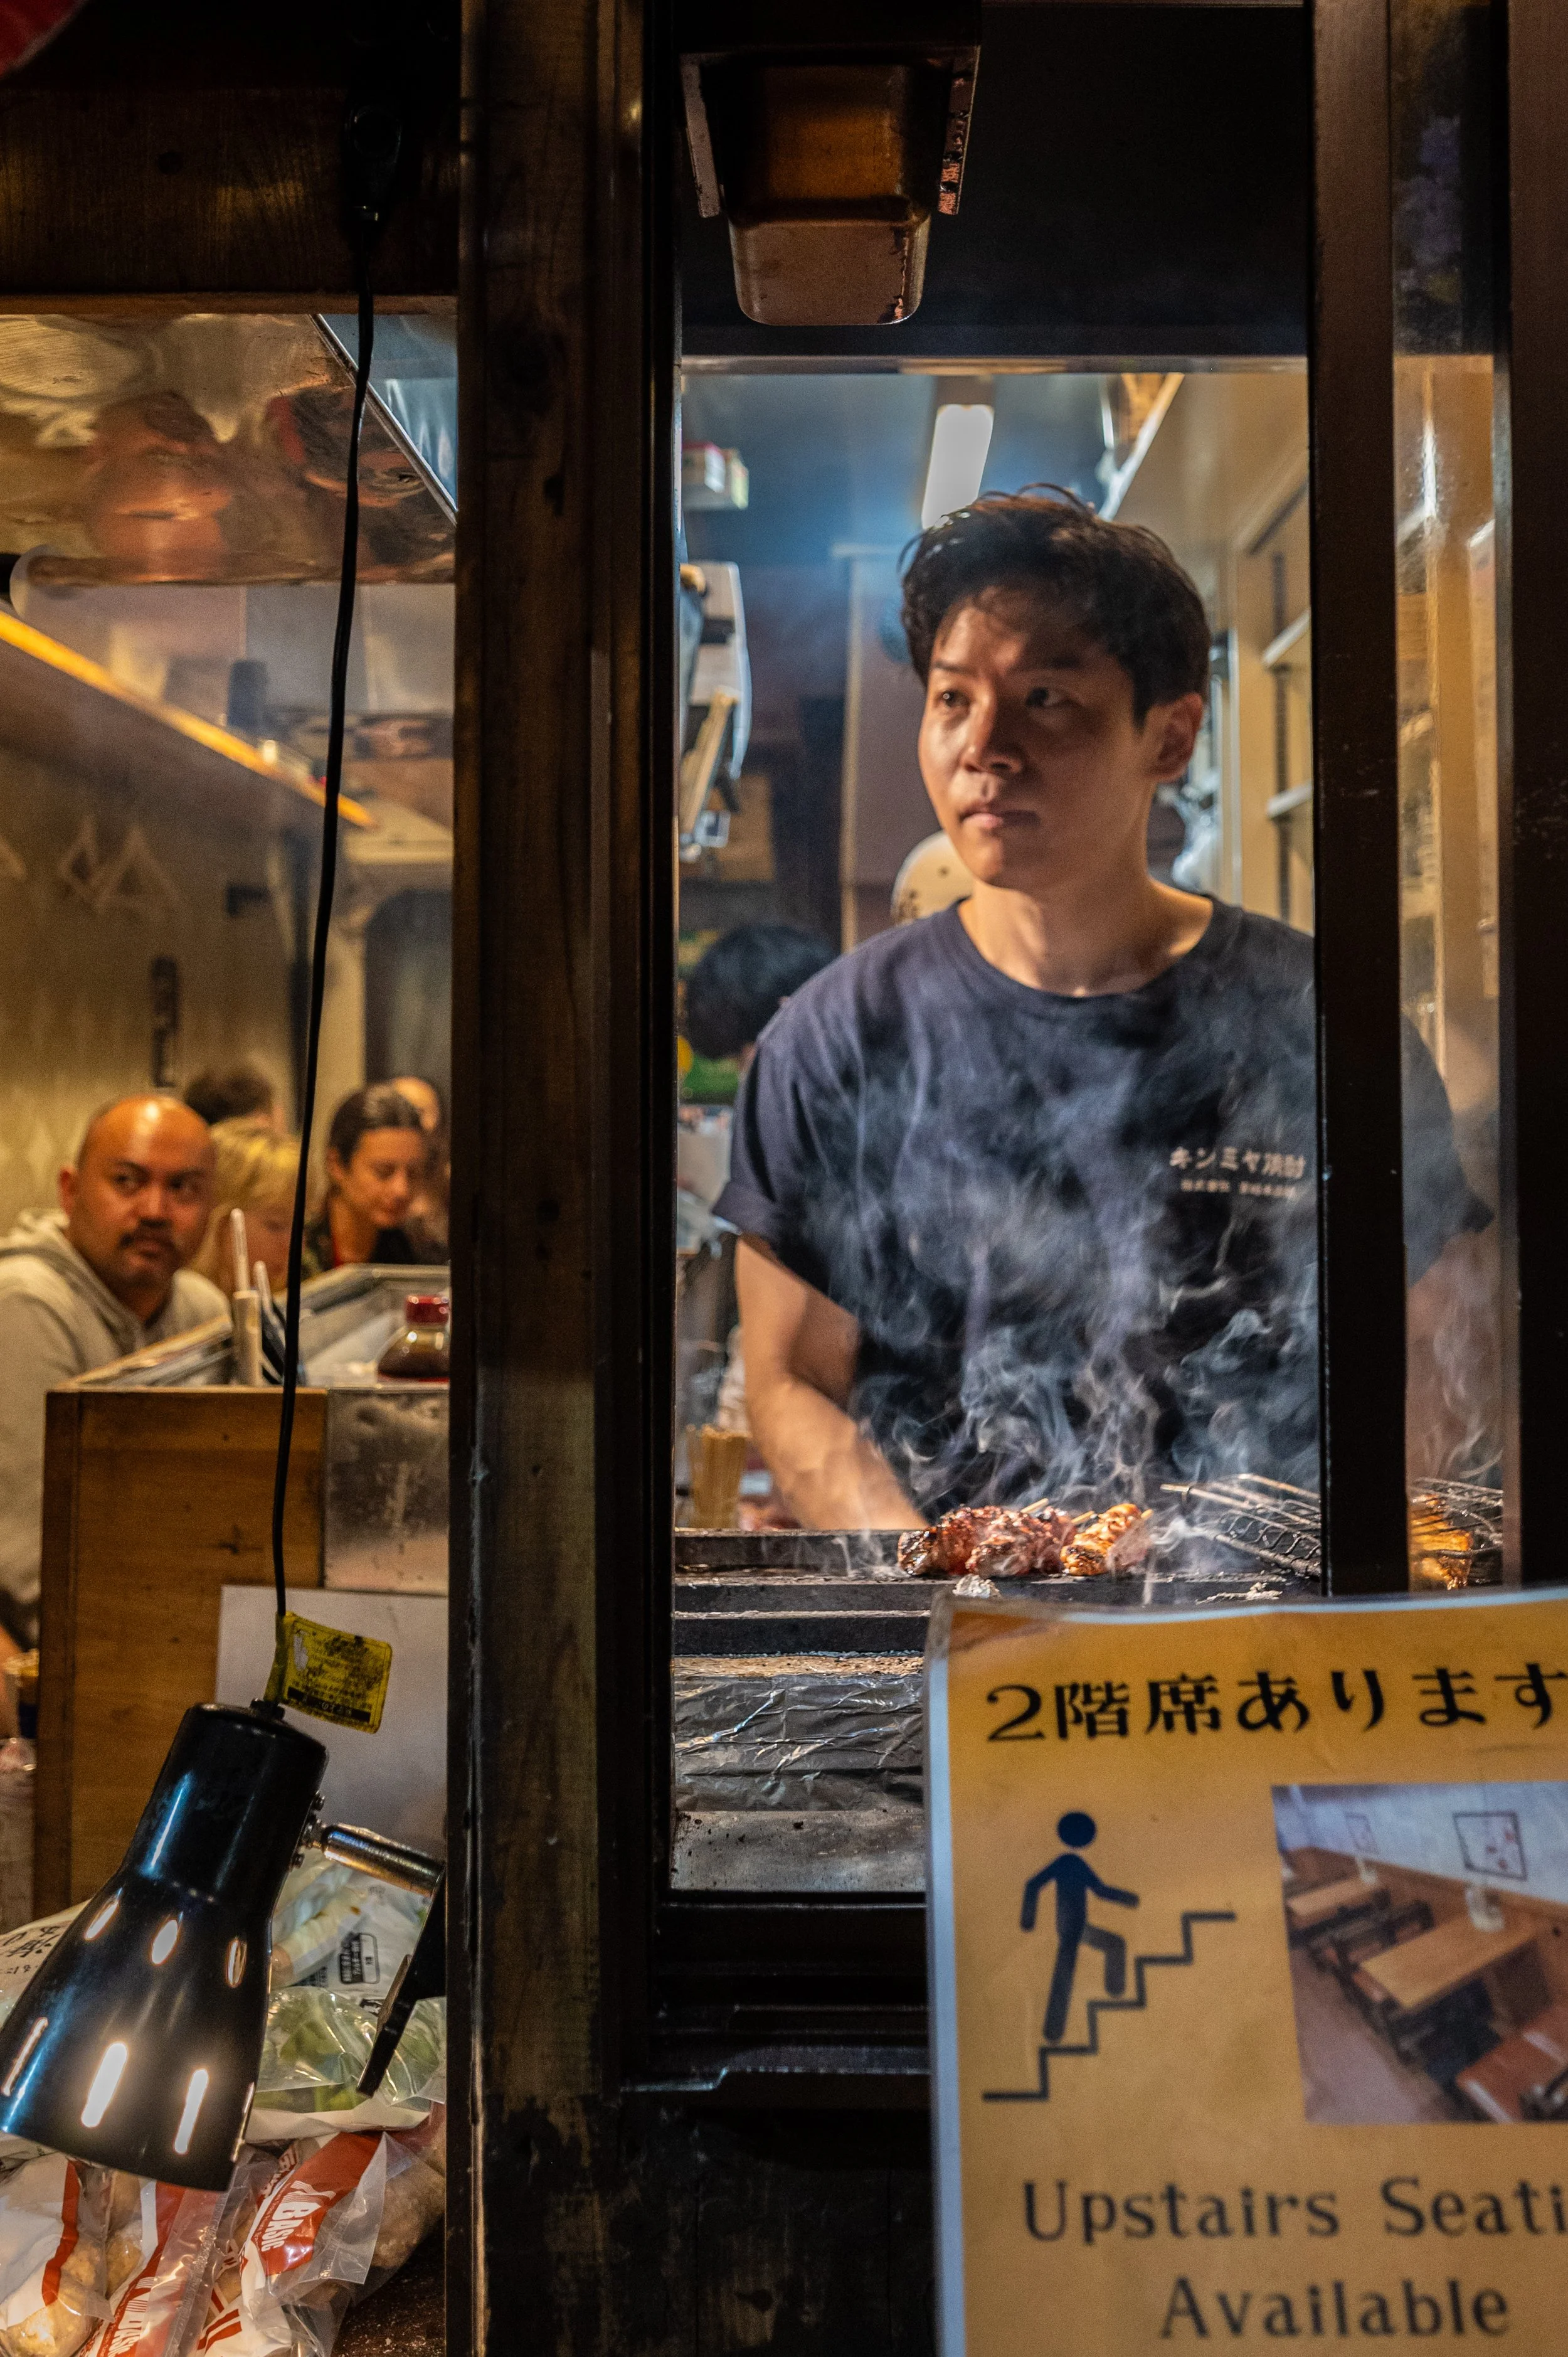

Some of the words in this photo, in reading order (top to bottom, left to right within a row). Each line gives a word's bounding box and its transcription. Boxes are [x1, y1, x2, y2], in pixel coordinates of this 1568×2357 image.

[985, 1661, 1568, 1742] 2階席あります
[261, 2201, 322, 2252] BASIC
[1022, 2179, 1340, 2245] Upstairs
[1160, 2276, 1508, 2339] Available
